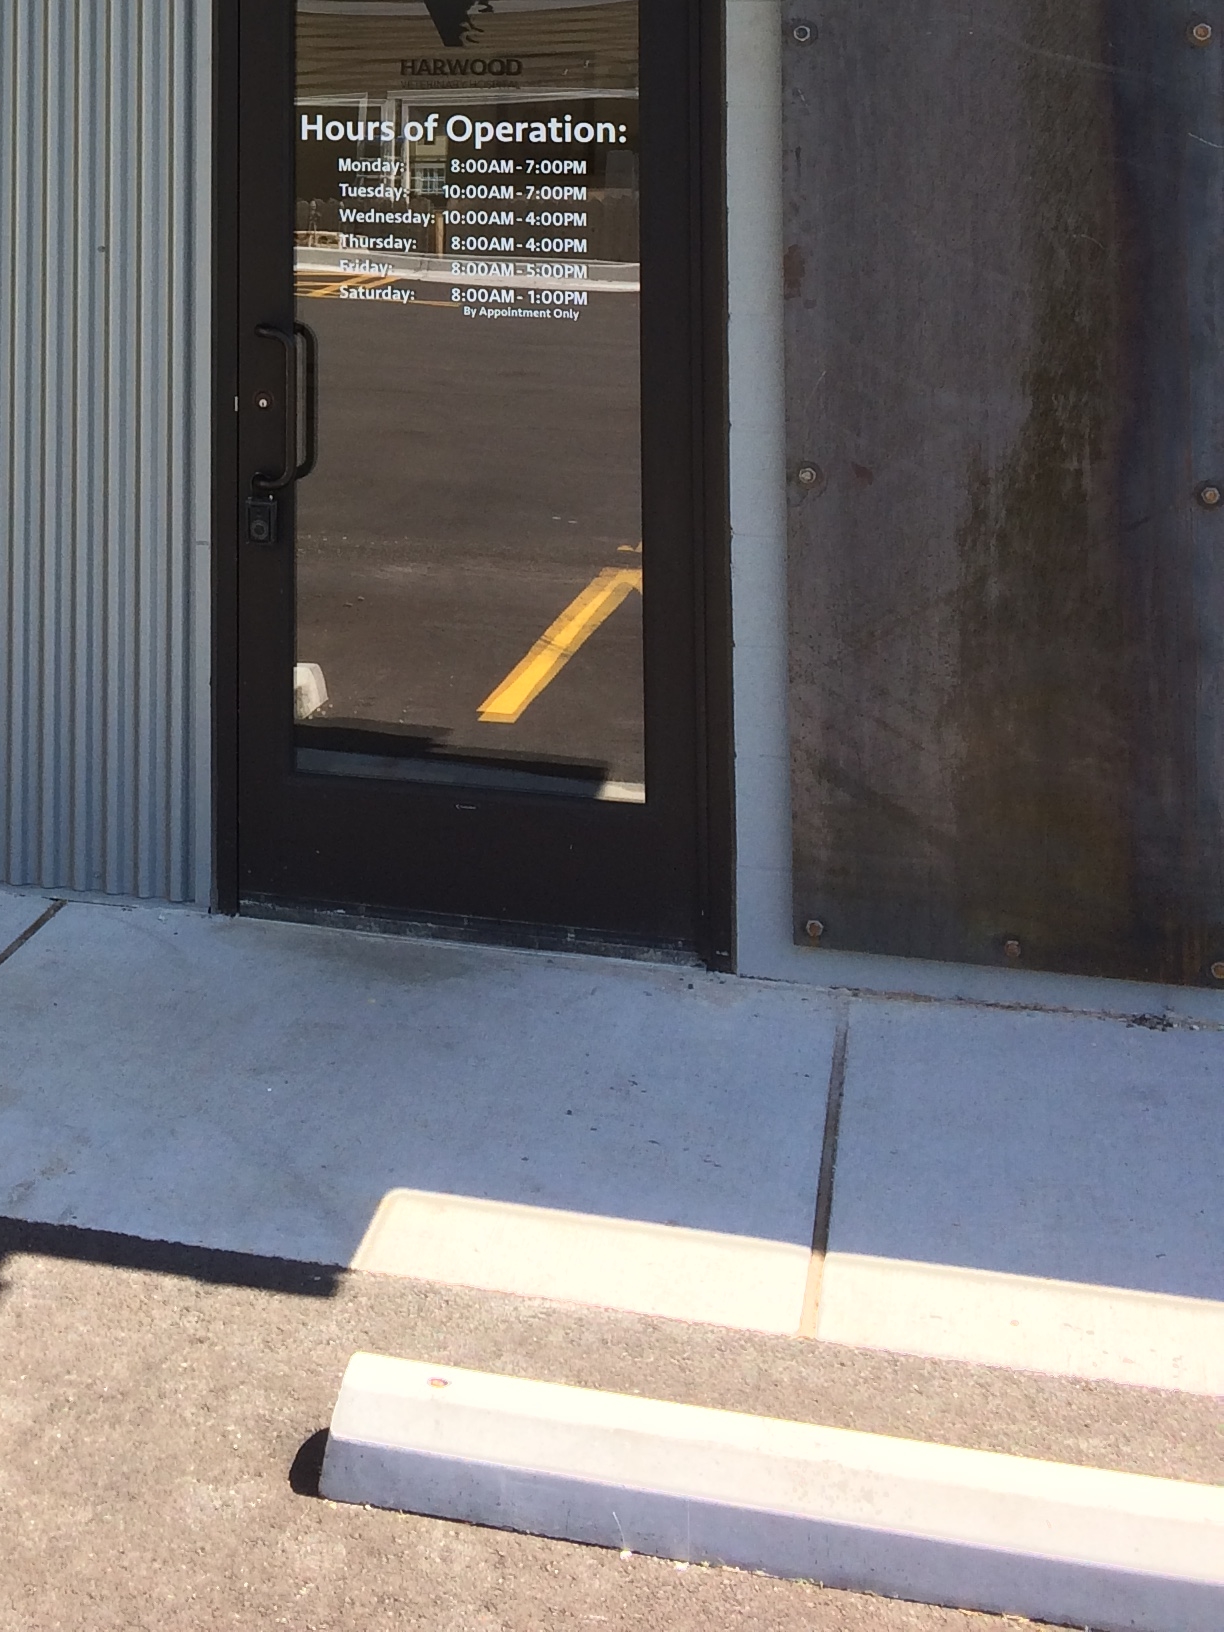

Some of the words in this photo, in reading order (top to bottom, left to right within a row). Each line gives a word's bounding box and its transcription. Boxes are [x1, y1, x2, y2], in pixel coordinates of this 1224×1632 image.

[400, 58, 524, 76] HARWOOD
[301, 114, 396, 141] Hours
[403, 113, 439, 142] of
[445, 114, 627, 149] Operation:
[338, 157, 405, 175] Monday:
[338, 183, 409, 200] Tuesday:
[339, 208, 435, 227] Wednesday:
[339, 234, 417, 252] Thursday:
[339, 259, 393, 278] Friday:
[339, 285, 415, 304] Saturday:
[463, 306, 477, 318] By
[479, 306, 551, 319] Appointment
[553, 308, 580, 321] Only
